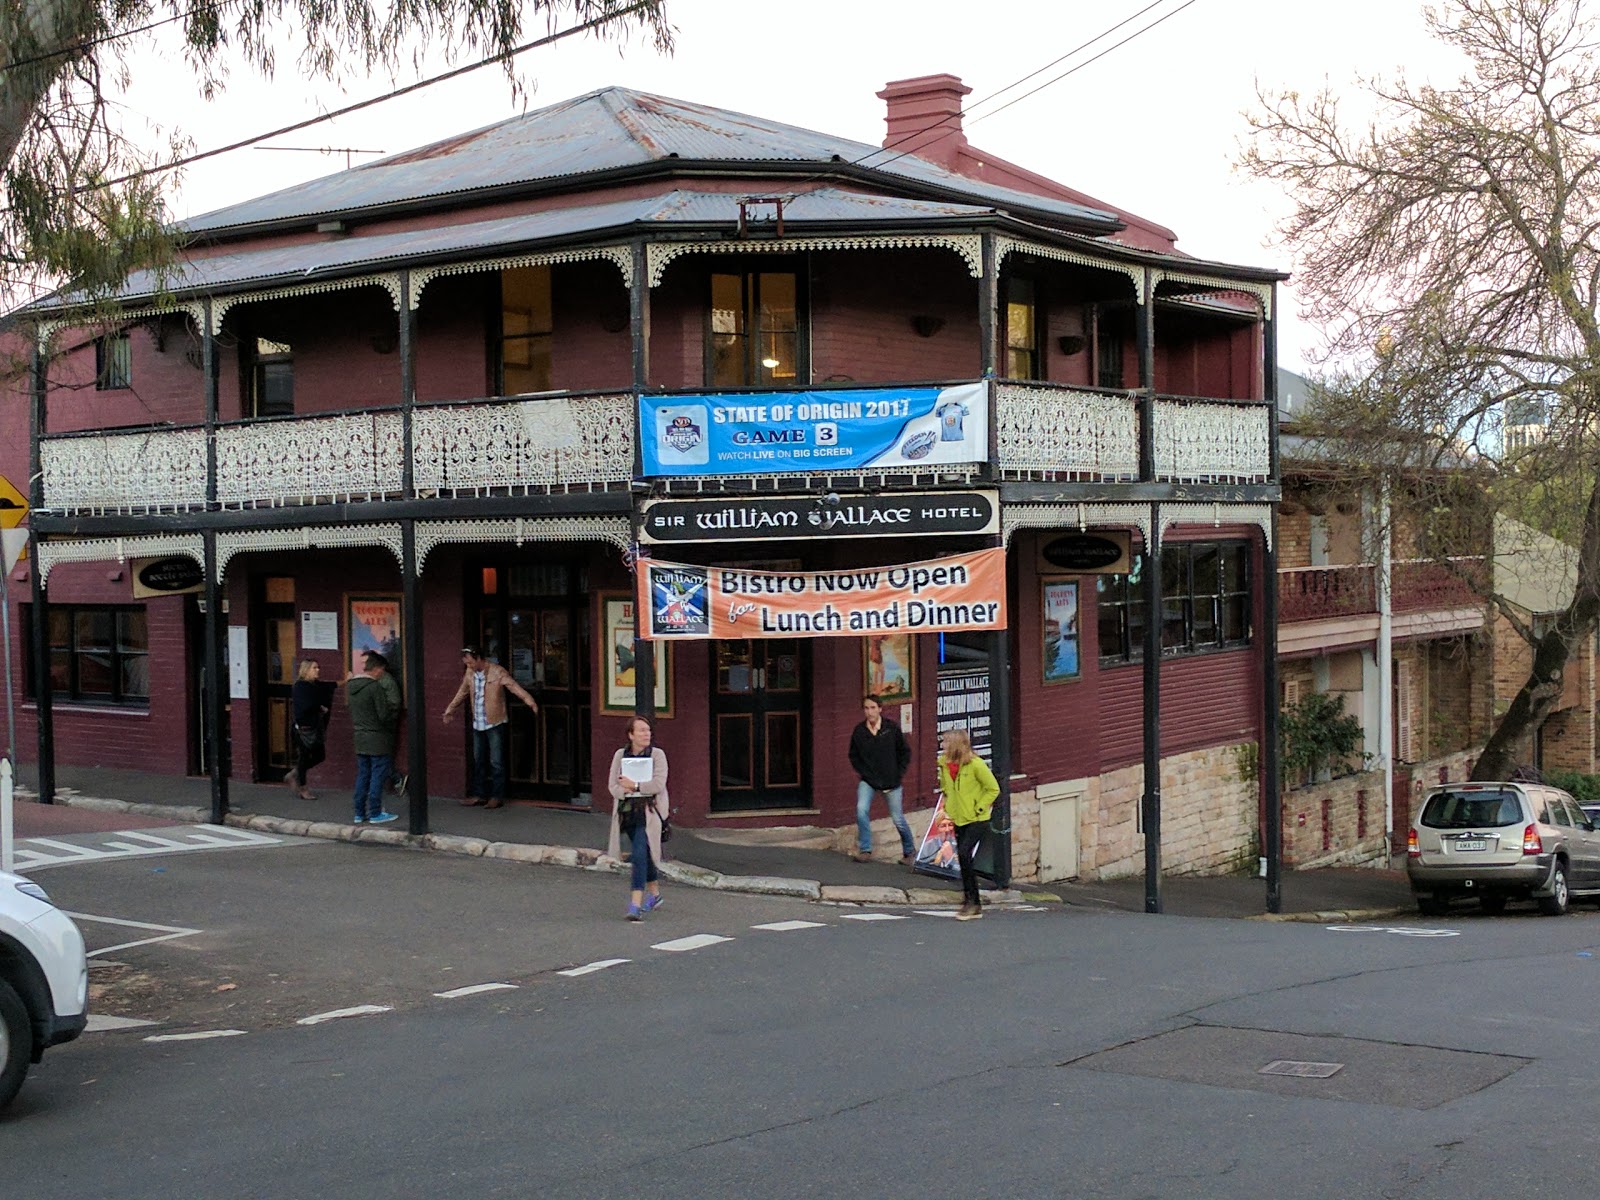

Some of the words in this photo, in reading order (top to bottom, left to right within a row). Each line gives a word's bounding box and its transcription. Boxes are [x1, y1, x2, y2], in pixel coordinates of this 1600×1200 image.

[713, 406, 767, 423] STATE
[771, 404, 794, 421] OF
[797, 402, 862, 420] ORIGIN
[865, 398, 911, 418] 2017
[662, 434, 703, 443] ORIGIN
[732, 429, 805, 445] GAME
[820, 428, 833, 441] 3
[718, 451, 751, 460] WATCH
[753, 450, 775, 459] LIVE
[777, 449, 791, 458] ON
[793, 449, 811, 458] BIG
[813, 447, 853, 457] SCREEN
[654, 516, 685, 527] SIR
[921, 507, 983, 519] HOTEL
[721, 571, 806, 594] Bistro
[815, 571, 880, 591] Now
[887, 564, 967, 594] Open
[657, 615, 704, 624] WALLACE
[728, 602, 756, 623] for
[762, 604, 841, 632] Lunch
[849, 601, 899, 630] and
[907, 599, 998, 627] Dinner
[941, 678, 965, 692] WILLIAM
[965, 676, 989, 690] WALLACE
